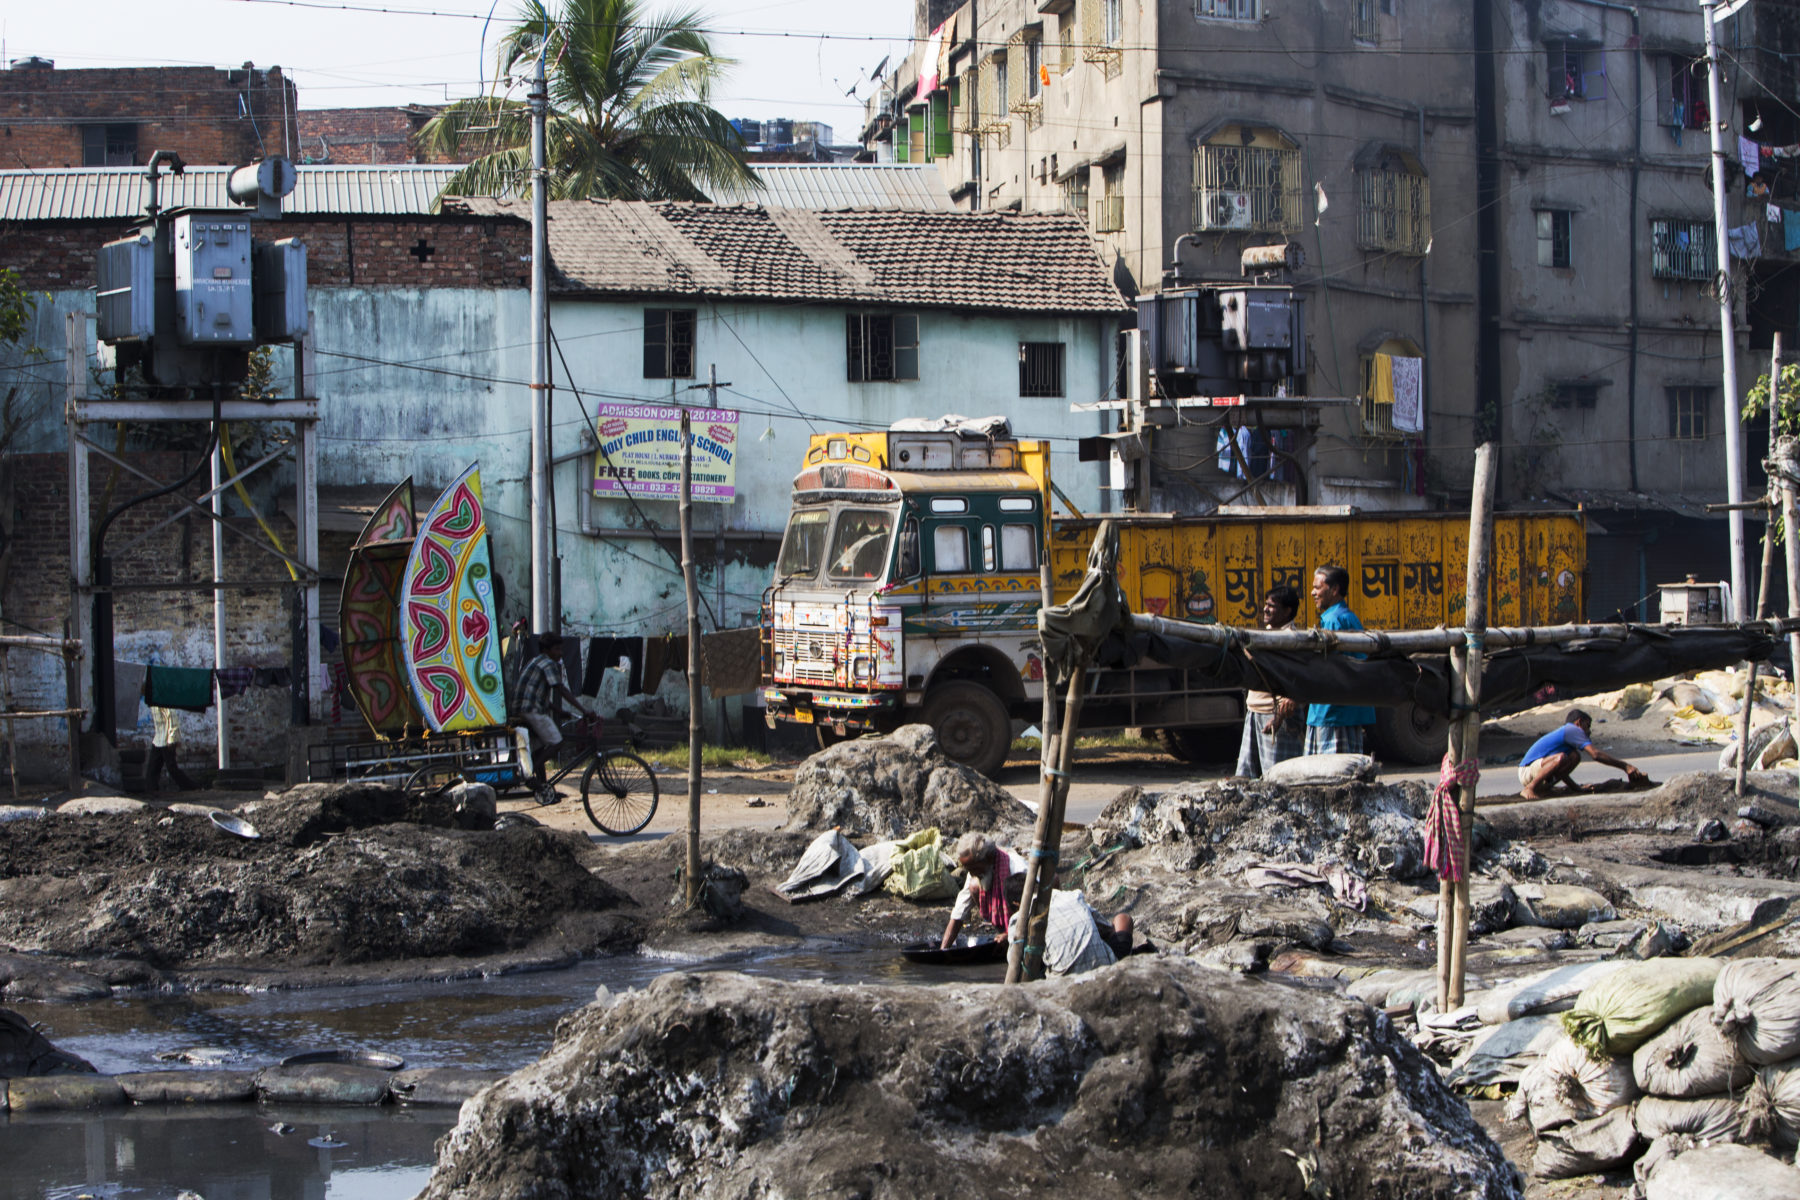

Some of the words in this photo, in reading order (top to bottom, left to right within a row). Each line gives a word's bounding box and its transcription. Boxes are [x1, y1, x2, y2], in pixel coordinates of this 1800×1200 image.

[601, 405, 658, 418] ADMISSION
[660, 408, 681, 419] OPE
[690, 410, 736, 422] (2012-13)
[625, 430, 653, 447] CHILD
[696, 435, 733, 465] SCHOOL
[599, 466, 635, 478] FREE
[613, 482, 645, 490] Contact
[650, 484, 666, 492] 033
